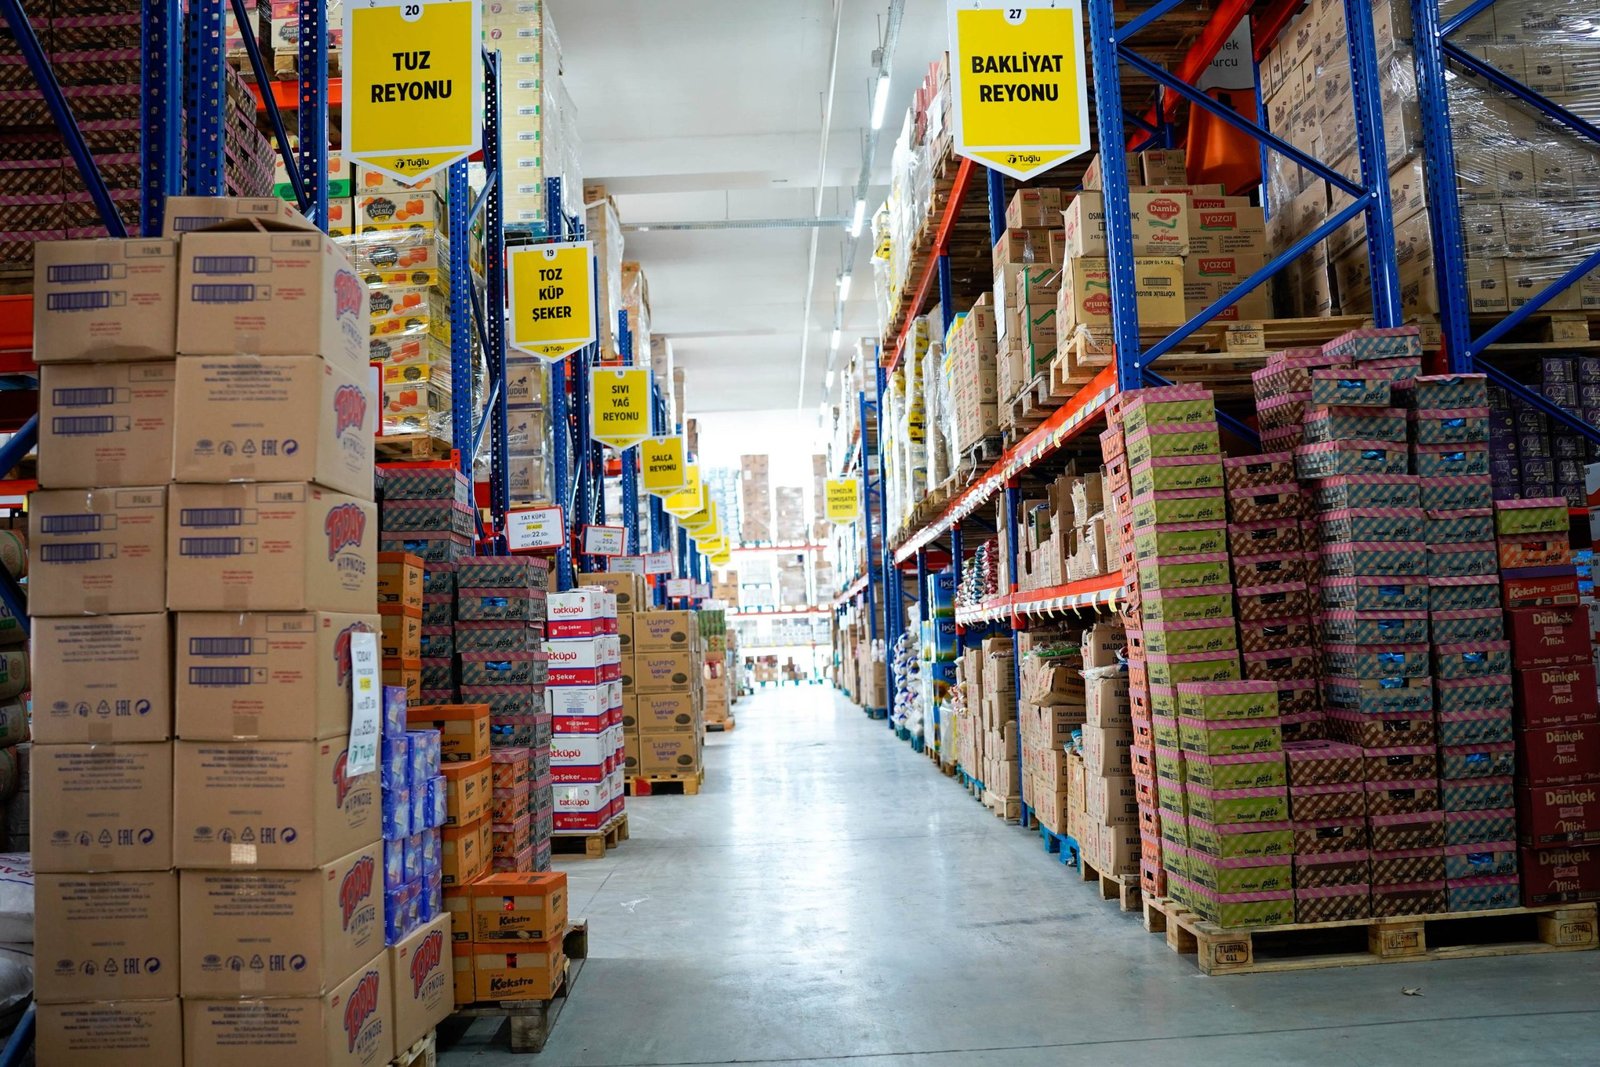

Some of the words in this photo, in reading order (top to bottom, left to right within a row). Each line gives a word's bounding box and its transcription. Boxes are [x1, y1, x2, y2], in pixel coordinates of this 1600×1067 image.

[405, 5, 420, 16] 20
[1009, 9, 1022, 19] 27
[392, 51, 430, 71] TUZ
[972, 52, 1063, 74] BAKLİYAT
[371, 80, 452, 103] REYONU
[980, 84, 1059, 102] REYONU
[406, 158, 430, 168] Tuğlu
[1018, 155, 1041, 164] Tuğlu
[1150, 204, 1179, 213] Damla
[1204, 215, 1233, 224] yazar
[546, 249, 554, 257] 19
[1202, 261, 1232, 270] yazar
[539, 268, 563, 282] TOZ
[539, 285, 564, 301] KÜP
[532, 306, 572, 322] ŞEKER
[612, 384, 629, 394] SIVI
[612, 396, 629, 407] YAĞ
[603, 412, 639, 421] REYONU
[652, 454, 673, 463] SALÇA
[650, 464, 676, 473] REYONU
[325, 503, 366, 562] TODAY
[337, 556, 366, 575] HYPNOSE
[1508, 587, 1546, 600] Kekstre
[553, 604, 584, 614] tatküpü
[1540, 636, 1566, 646] Mini
[556, 672, 576, 681] Şeker
[1541, 670, 1580, 684] Dankek
[1548, 694, 1574, 705] Mini
[1546, 730, 1585, 744] Dankek
[1552, 754, 1578, 764] Mini
[345, 792, 372, 814] HYPNOSE
[559, 798, 590, 807] tatküpü
[1545, 788, 1596, 806] Dankek
[1554, 820, 1586, 833] Mini
[1539, 850, 1591, 866] Dankek
[1548, 879, 1582, 892] Mini
[339, 856, 375, 932] TODAY
[350, 906, 375, 934] HYPNOSE
[499, 916, 530, 926] Kekstre
[1563, 925, 1590, 935] TURPAL
[1220, 942, 1246, 954] TURPAL
[410, 930, 444, 1000] TODAY
[422, 974, 444, 1000] HYPNOSE
[490, 977, 534, 991] Kekstre
[344, 970, 380, 1054] TODAY
[356, 1020, 382, 1053] HYPNOSE
